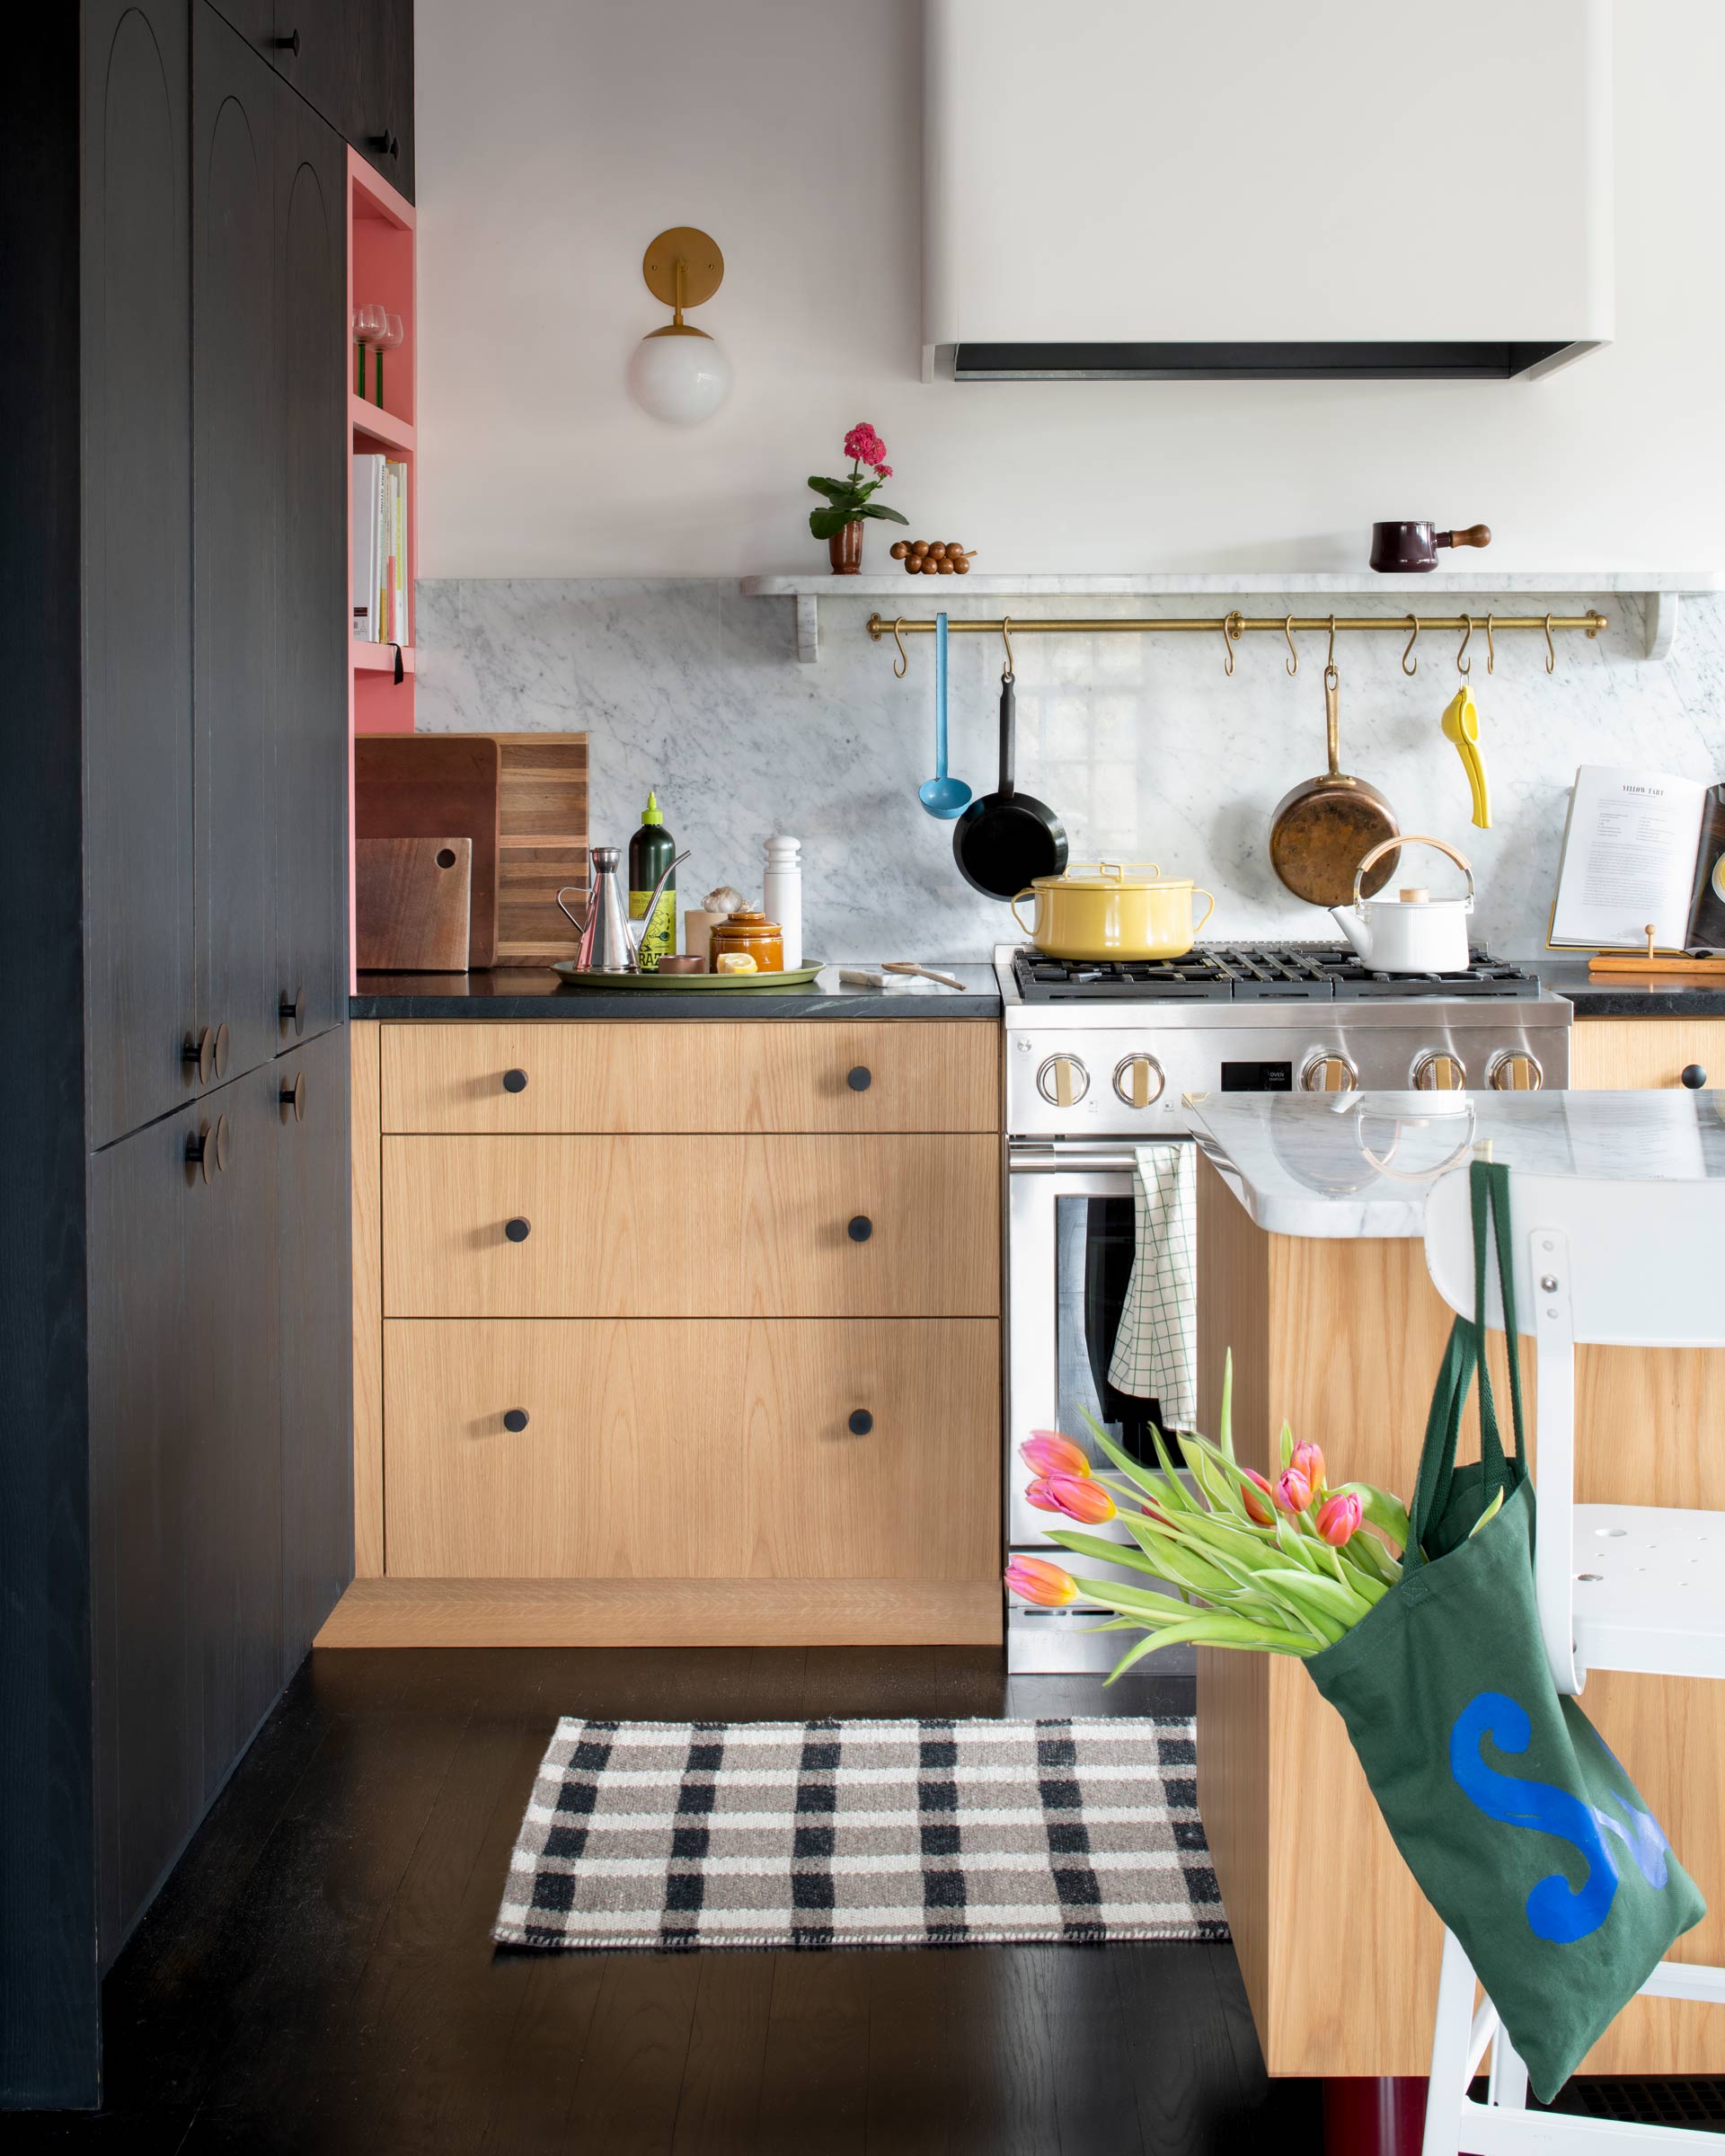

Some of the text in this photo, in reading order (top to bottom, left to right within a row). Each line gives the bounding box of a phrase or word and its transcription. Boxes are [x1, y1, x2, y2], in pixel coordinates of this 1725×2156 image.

[1623, 784, 1664, 796] YELLOW TART
[639, 952, 668, 966] RAZ
